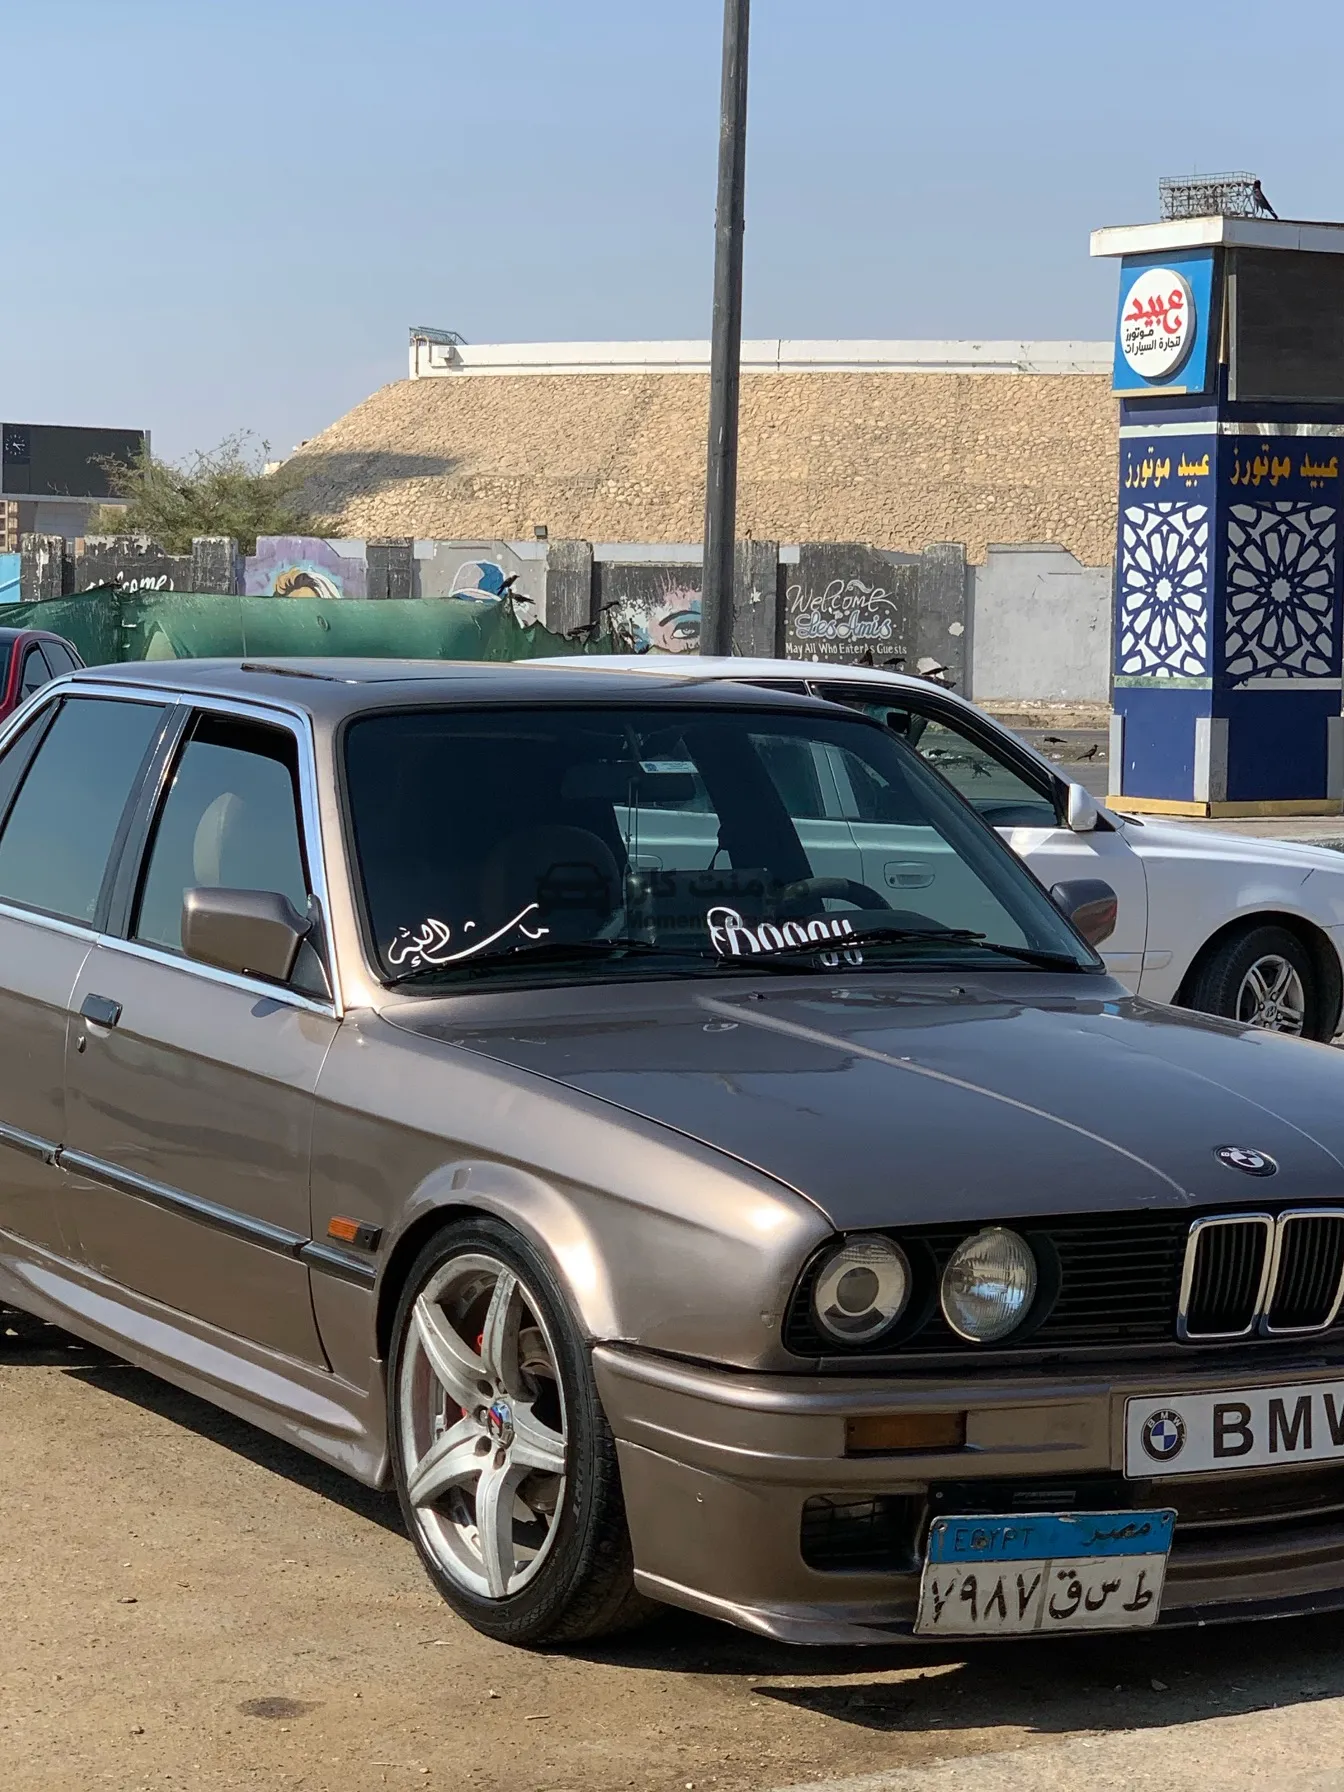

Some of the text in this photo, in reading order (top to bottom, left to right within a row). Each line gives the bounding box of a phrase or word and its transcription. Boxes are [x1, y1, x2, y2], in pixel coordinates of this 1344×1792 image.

[1124, 289, 1184, 334] عبيد
[1125, 336, 1181, 355] لتجارة السيارات
[1126, 327, 1154, 342] موتورز
[1125, 446, 1210, 488] عبيد موتورز
[1229, 444, 1339, 488] عبيد موتورز
[786, 580, 897, 613] Welcome
[795, 610, 891, 639] Les Amis
[785, 642, 803, 659] May
[805, 643, 817, 654] All
[820, 643, 838, 654] Who
[839, 643, 864, 655] Enter
[876, 643, 907, 655] Guests
[954, 1527, 1035, 1551] EGYPT
[1082, 1522, 1151, 1547] مصر
